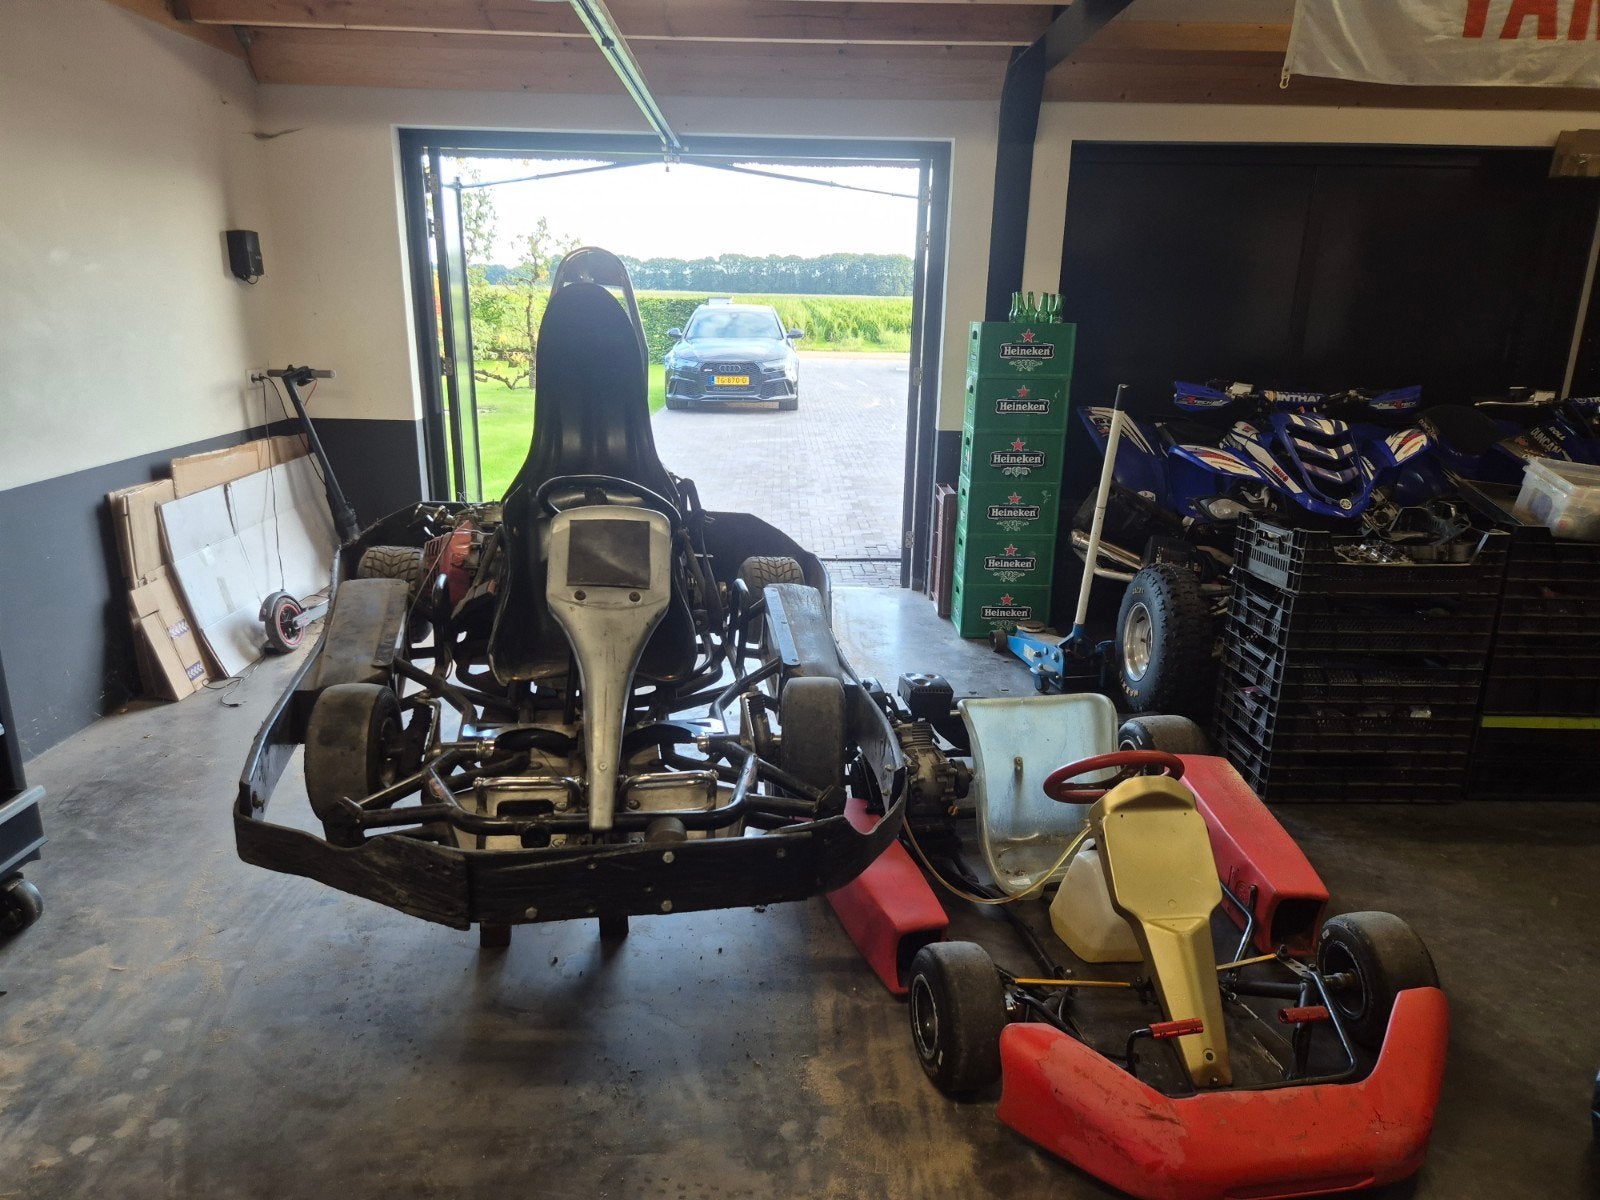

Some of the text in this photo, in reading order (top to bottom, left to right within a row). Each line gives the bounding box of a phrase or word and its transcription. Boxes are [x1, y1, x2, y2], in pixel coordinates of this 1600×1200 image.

[1004, 346, 1050, 356] Heineken
[1000, 401, 1046, 411] Heineken
[993, 454, 1041, 464] Heineken
[991, 508, 1036, 517] Heineken
[988, 559, 1032, 568] Heineken
[984, 608, 1028, 618] Heineken
